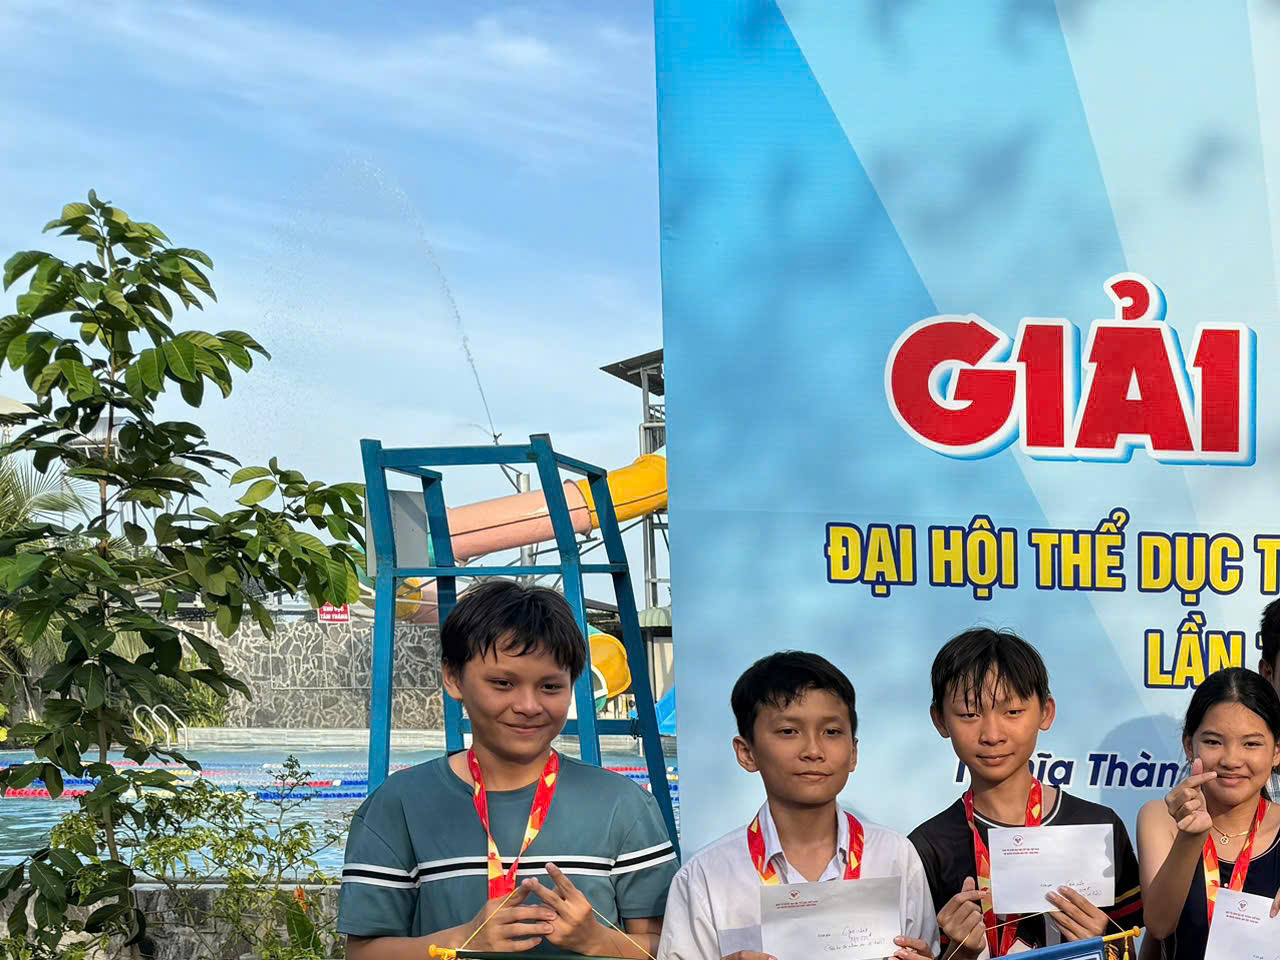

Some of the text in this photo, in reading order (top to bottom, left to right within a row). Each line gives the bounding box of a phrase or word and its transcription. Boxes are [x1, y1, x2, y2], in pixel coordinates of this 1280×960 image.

[887, 274, 1250, 460] GIẢI
[825, 522, 916, 598] ĐẠI
[928, 515, 1019, 600] HỘI
[1029, 507, 1130, 592] THỂ
[1137, 531, 1244, 606] DỤC
[1144, 611, 1246, 689] LẦN
